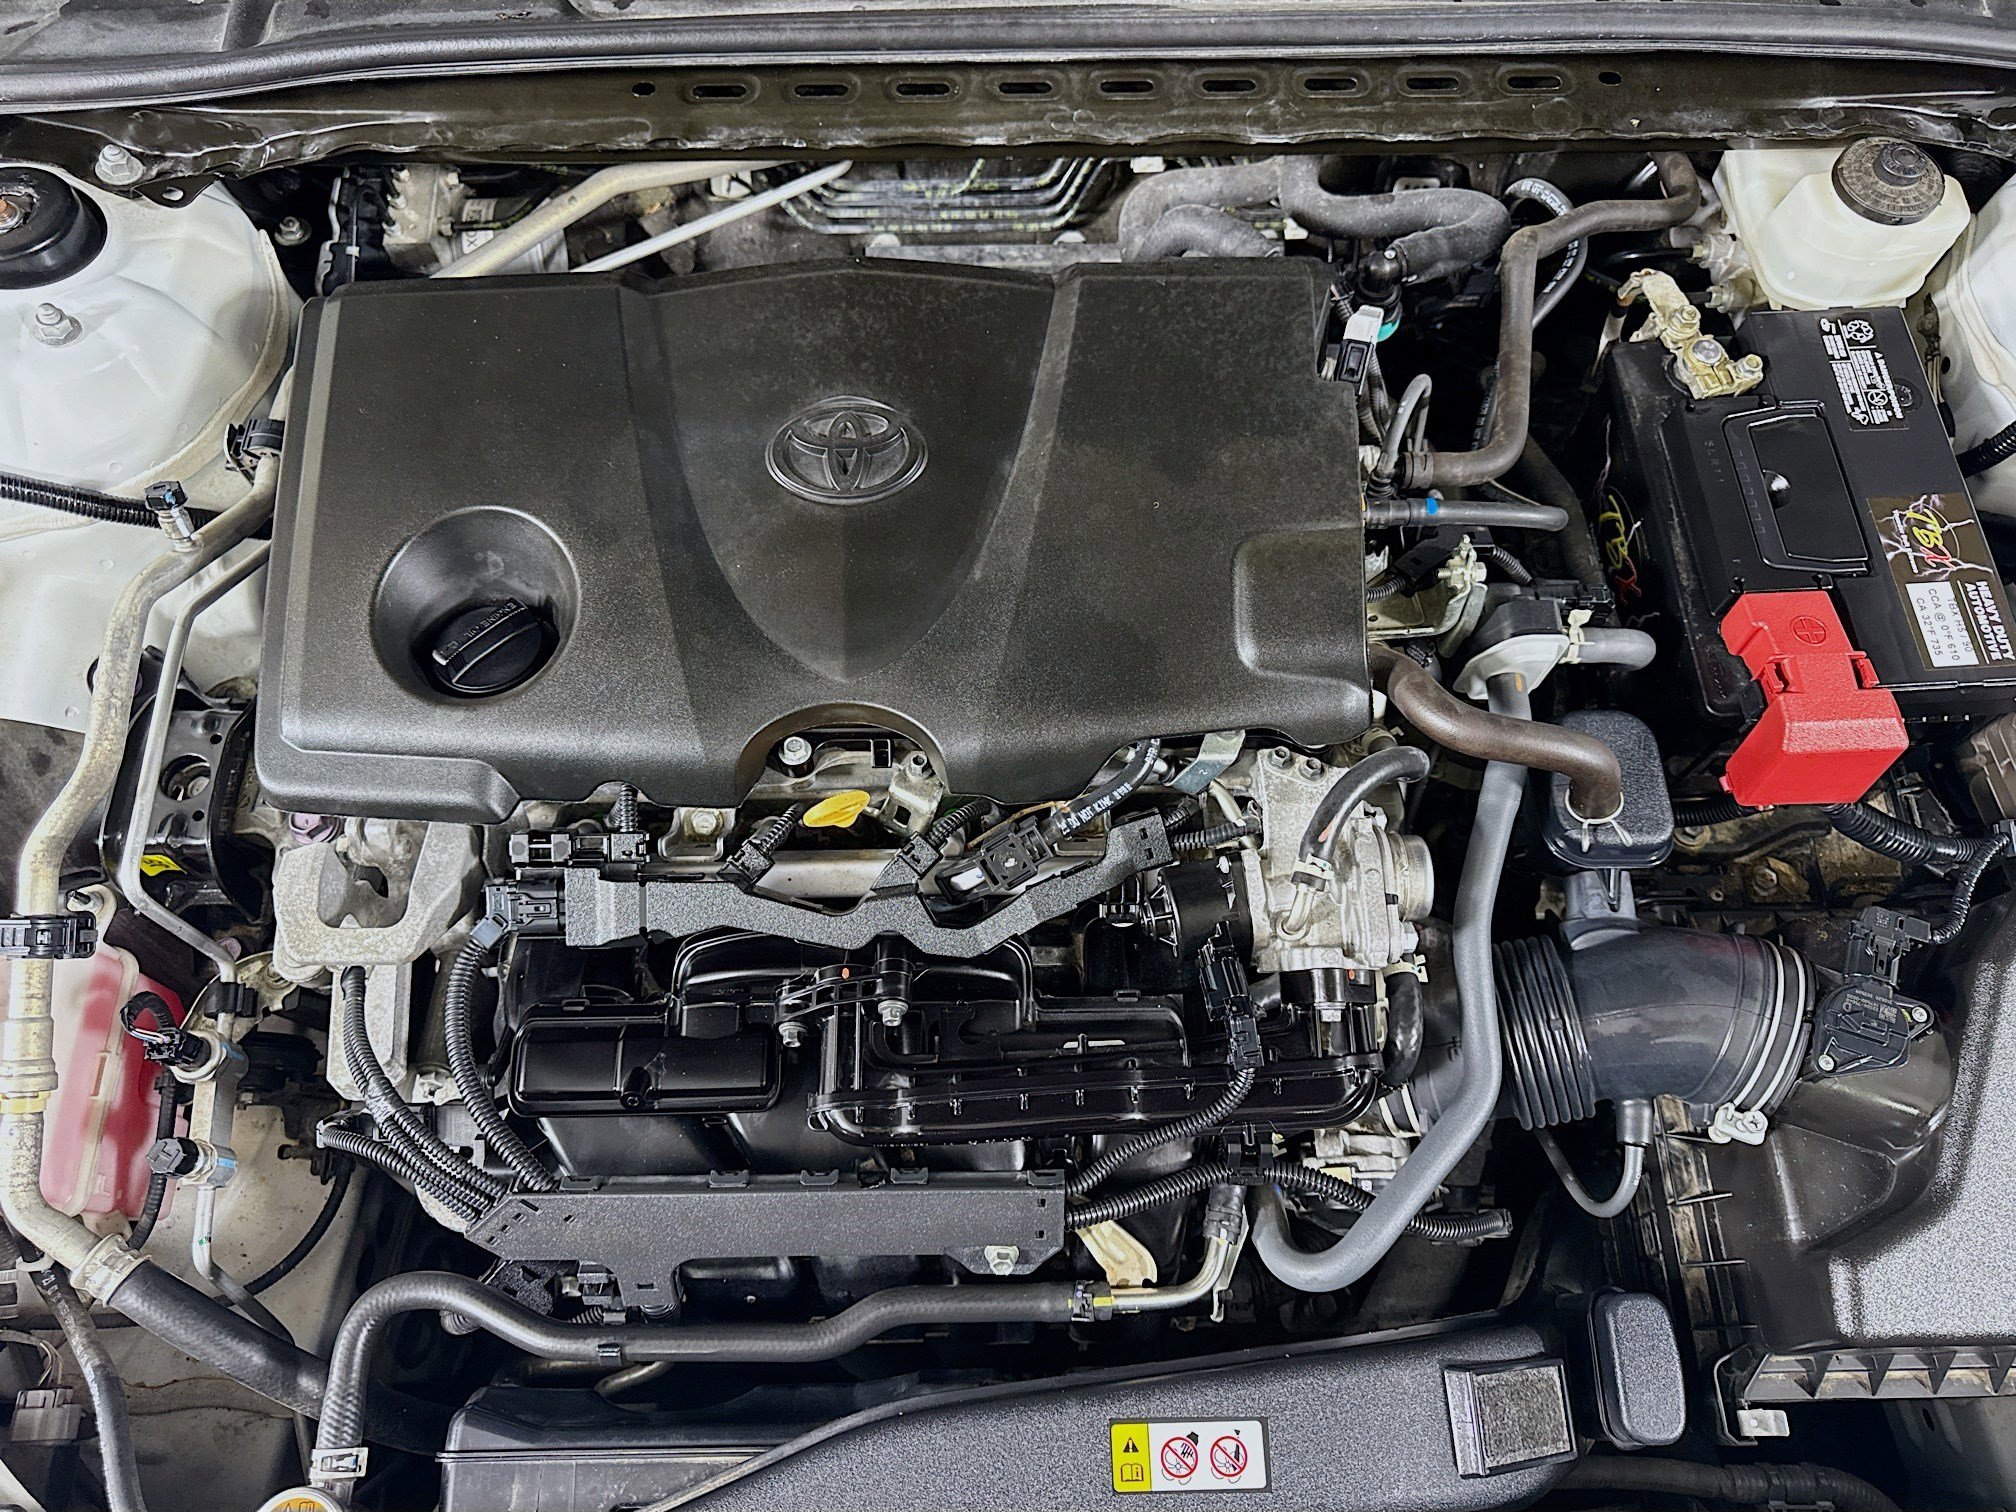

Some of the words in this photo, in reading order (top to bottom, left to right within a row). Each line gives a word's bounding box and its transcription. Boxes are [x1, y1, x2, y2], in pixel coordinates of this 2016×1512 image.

[1906, 508, 1956, 570] TBX
[1916, 597, 1927, 612] CA
[1928, 588, 1942, 610] CCA
[1921, 614, 1937, 636] 32°F
[1934, 612, 1946, 623] @
[1964, 582, 2003, 660] AUTOMOTIVE
[1976, 581, 2002, 623] HEAVY
[1991, 624, 2016, 660] DUTY
[1930, 638, 1943, 656] 735
[1947, 643, 1961, 661] 610
[1077, 806, 1094, 824] NOT
[1092, 795, 1115, 812] KINK
